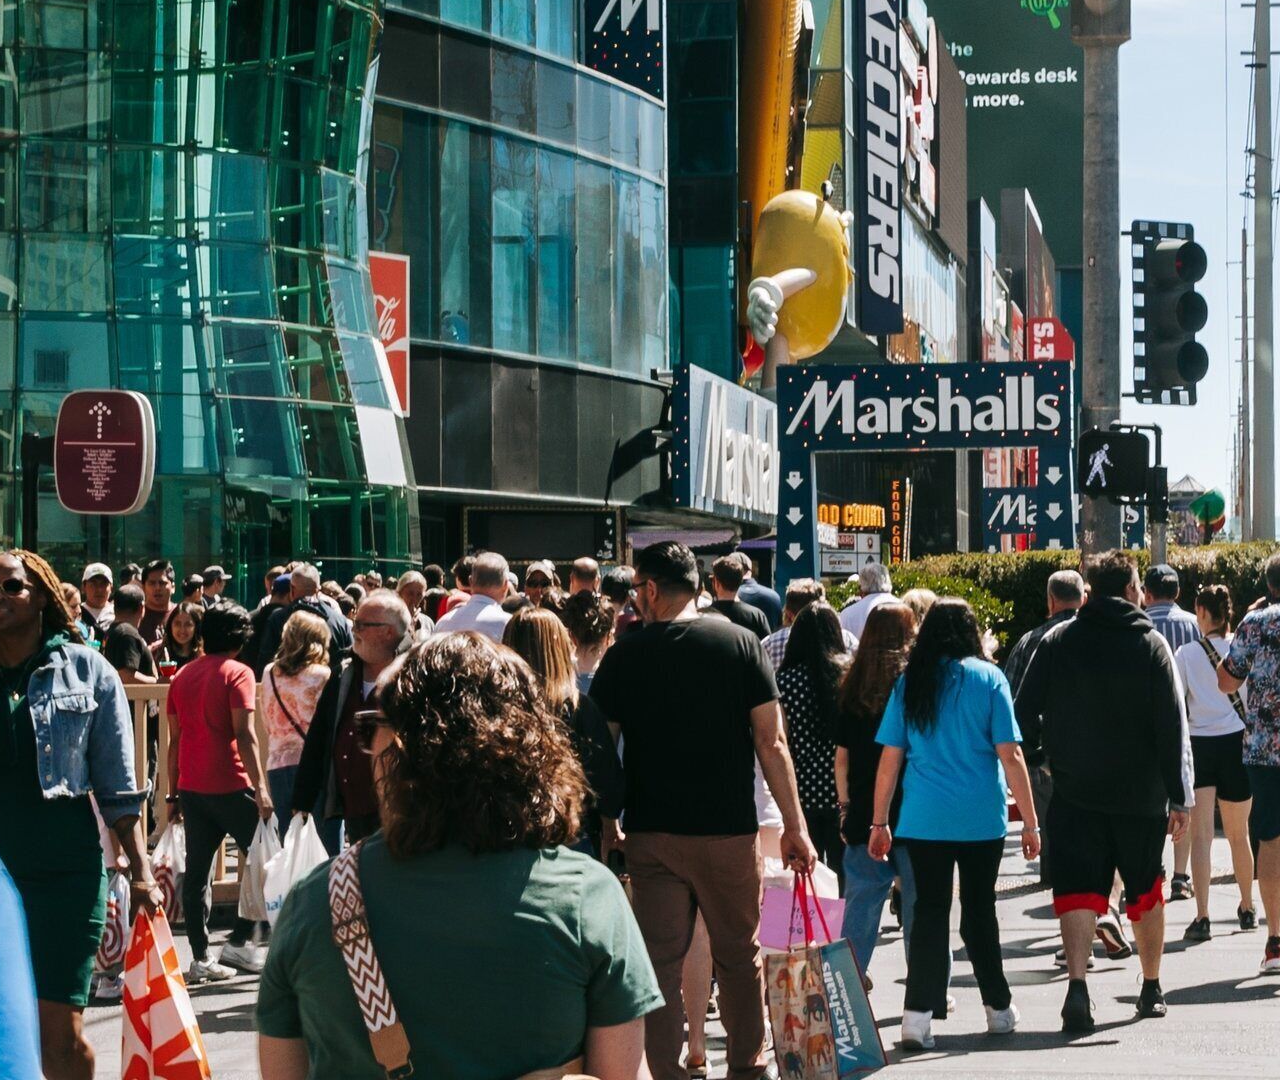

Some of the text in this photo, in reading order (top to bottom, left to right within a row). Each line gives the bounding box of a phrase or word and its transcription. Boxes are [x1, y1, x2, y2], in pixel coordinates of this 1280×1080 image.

[946, 41, 974, 57] he
[1034, 66, 1078, 84] desk
[972, 93, 1025, 108] more.
[785, 375, 1062, 435] Marshalls
[843, 504, 881, 527] COURT
[891, 480, 901, 565] FOOD COUR
[822, 961, 858, 1061] Marshalls
